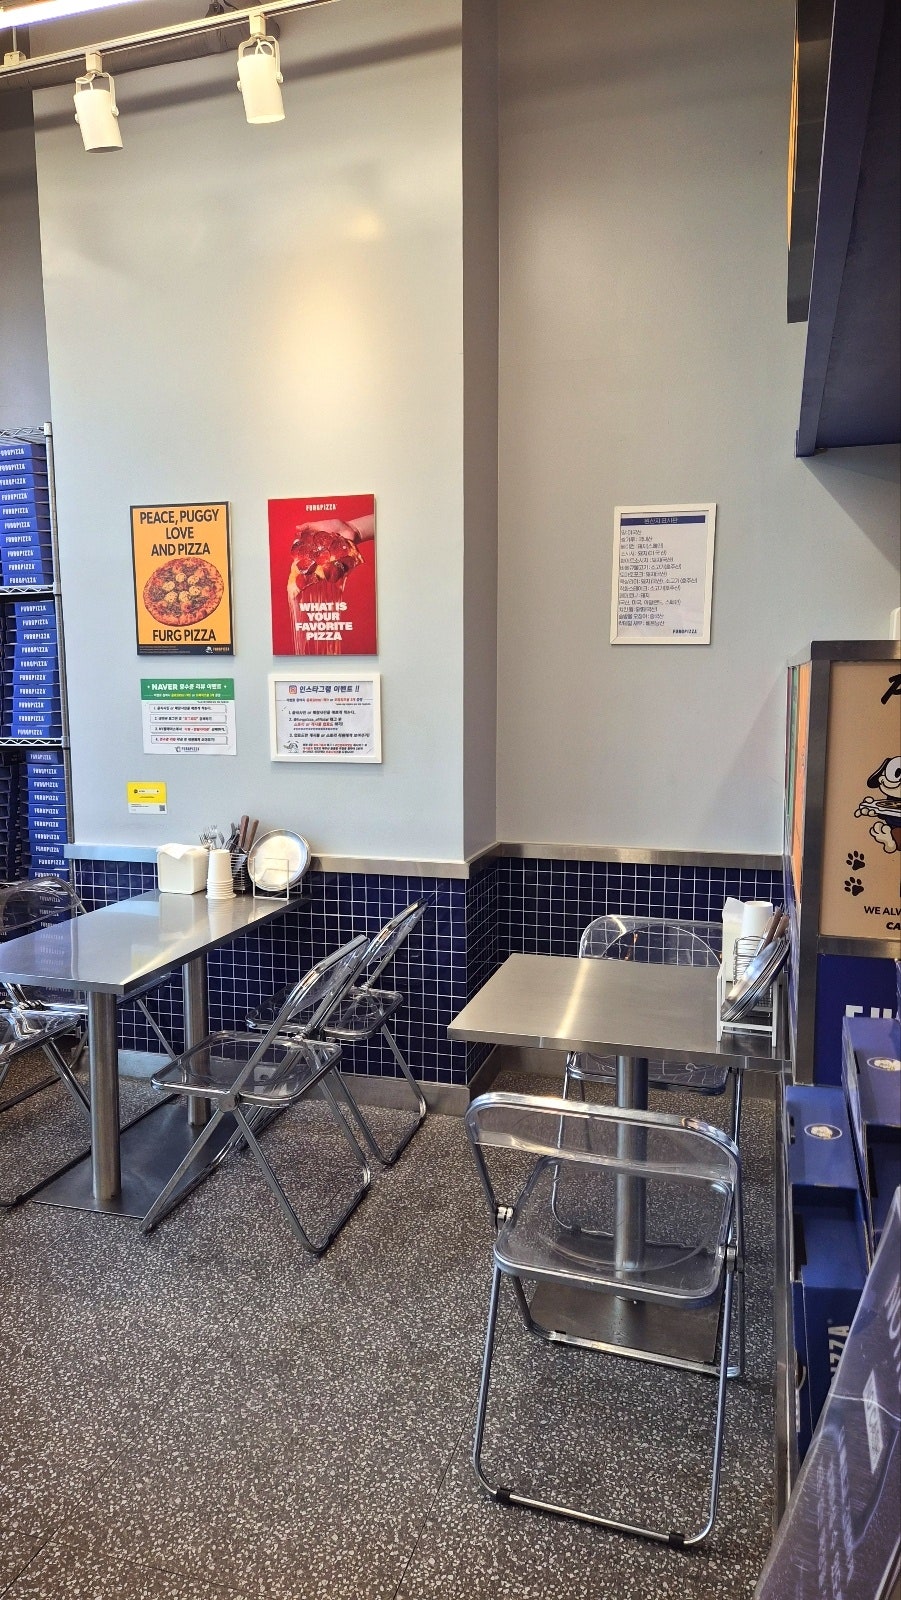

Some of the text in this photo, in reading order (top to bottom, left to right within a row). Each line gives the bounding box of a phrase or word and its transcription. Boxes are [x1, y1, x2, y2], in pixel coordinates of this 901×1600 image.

[140, 509, 219, 525] PEACE, PUGGY
[166, 527, 194, 539] LOVE
[151, 543, 210, 556] AND PIZZA
[299, 602, 347, 612] WHAT IS
[306, 612, 340, 621] YOUR
[295, 622, 352, 631] FAVORITE
[152, 629, 216, 642] FURG PIZZA
[306, 631, 342, 641] PIZZA
[299, 685, 331, 693] 인스타그램
[333, 685, 353, 693] 이벤트
[864, 906, 881, 915] WE
